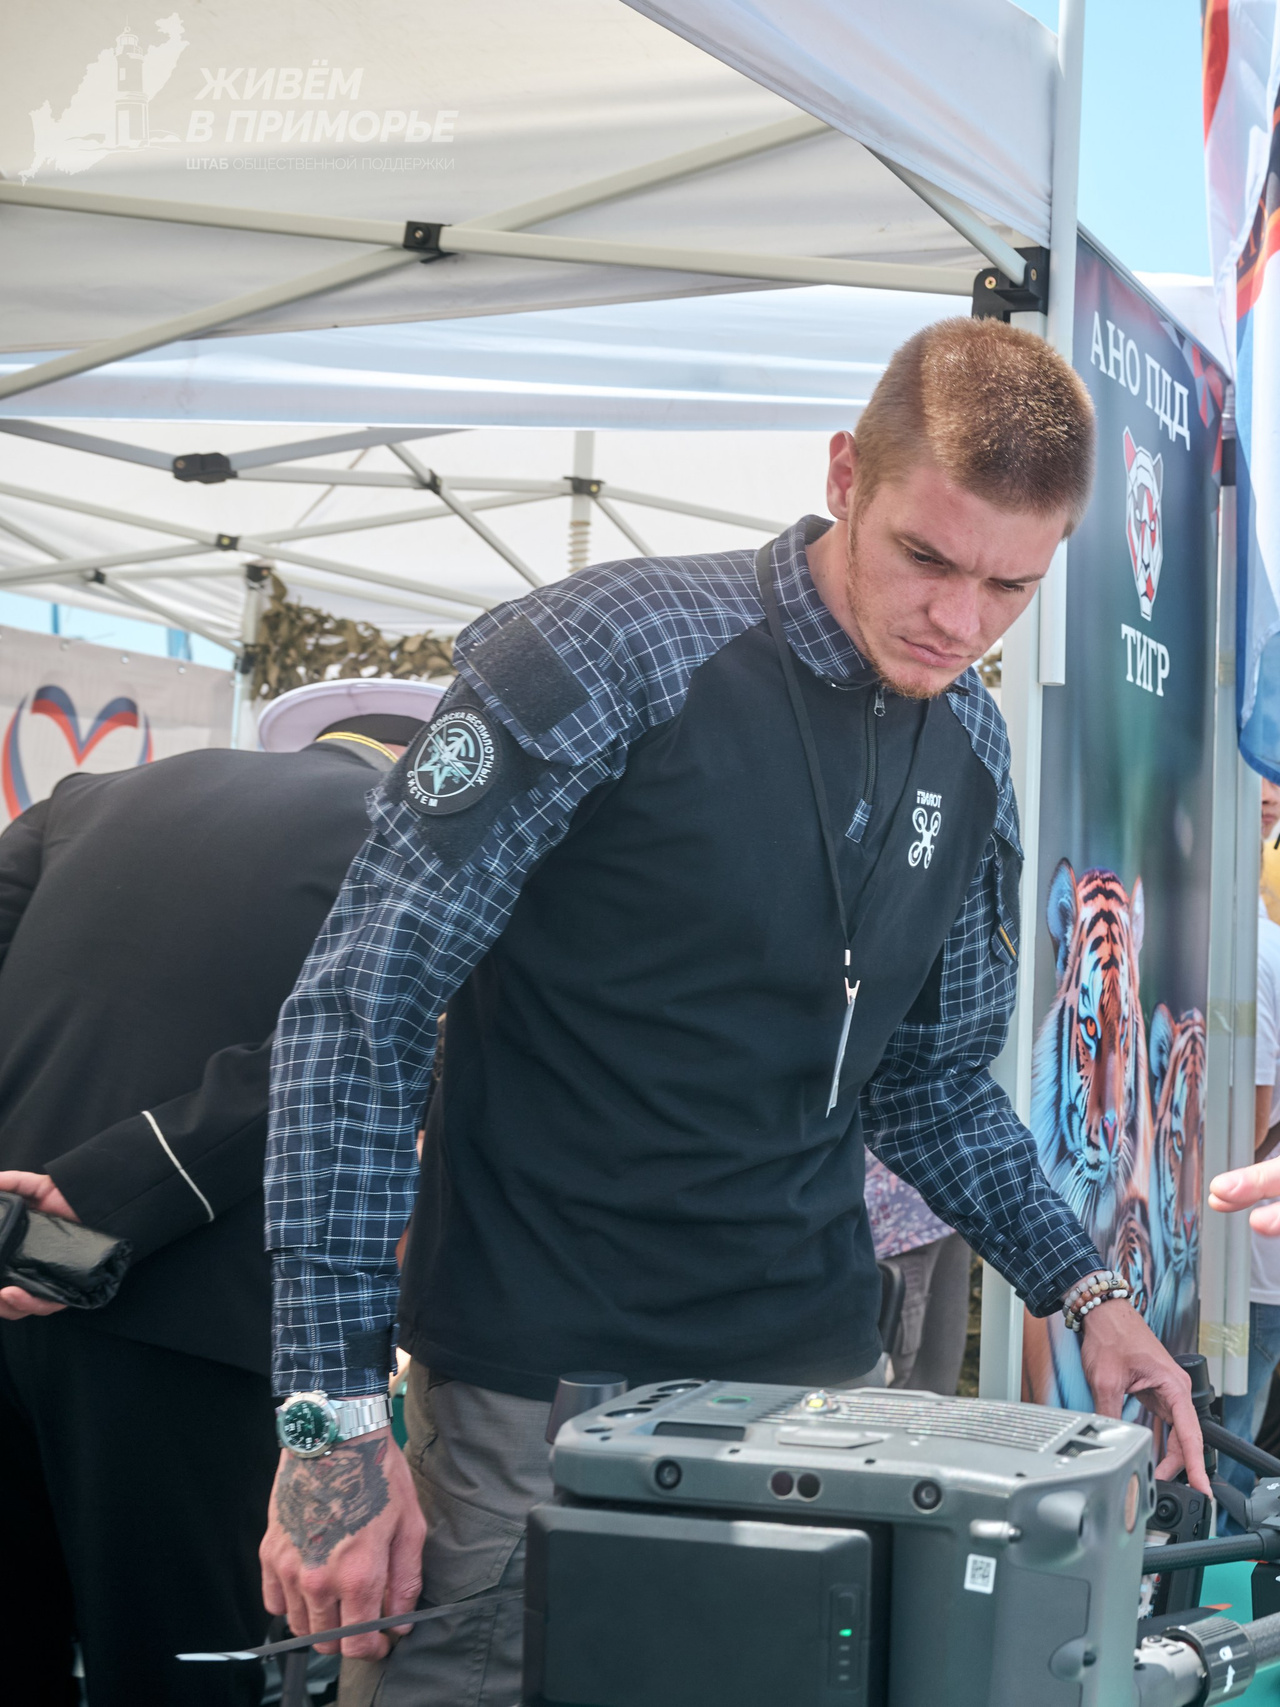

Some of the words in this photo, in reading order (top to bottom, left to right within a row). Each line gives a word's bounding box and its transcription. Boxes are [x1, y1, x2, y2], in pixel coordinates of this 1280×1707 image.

[1089, 311, 1142, 396] АНО
[1145, 353, 1191, 451] ПДД
[1121, 623, 1170, 697] ТИГР
[429, 711, 465, 732] ВОЙСКА
[464, 712, 495, 786] БЕСПИЛОТНЫХ
[406, 770, 439, 807] СИСТЕМ
